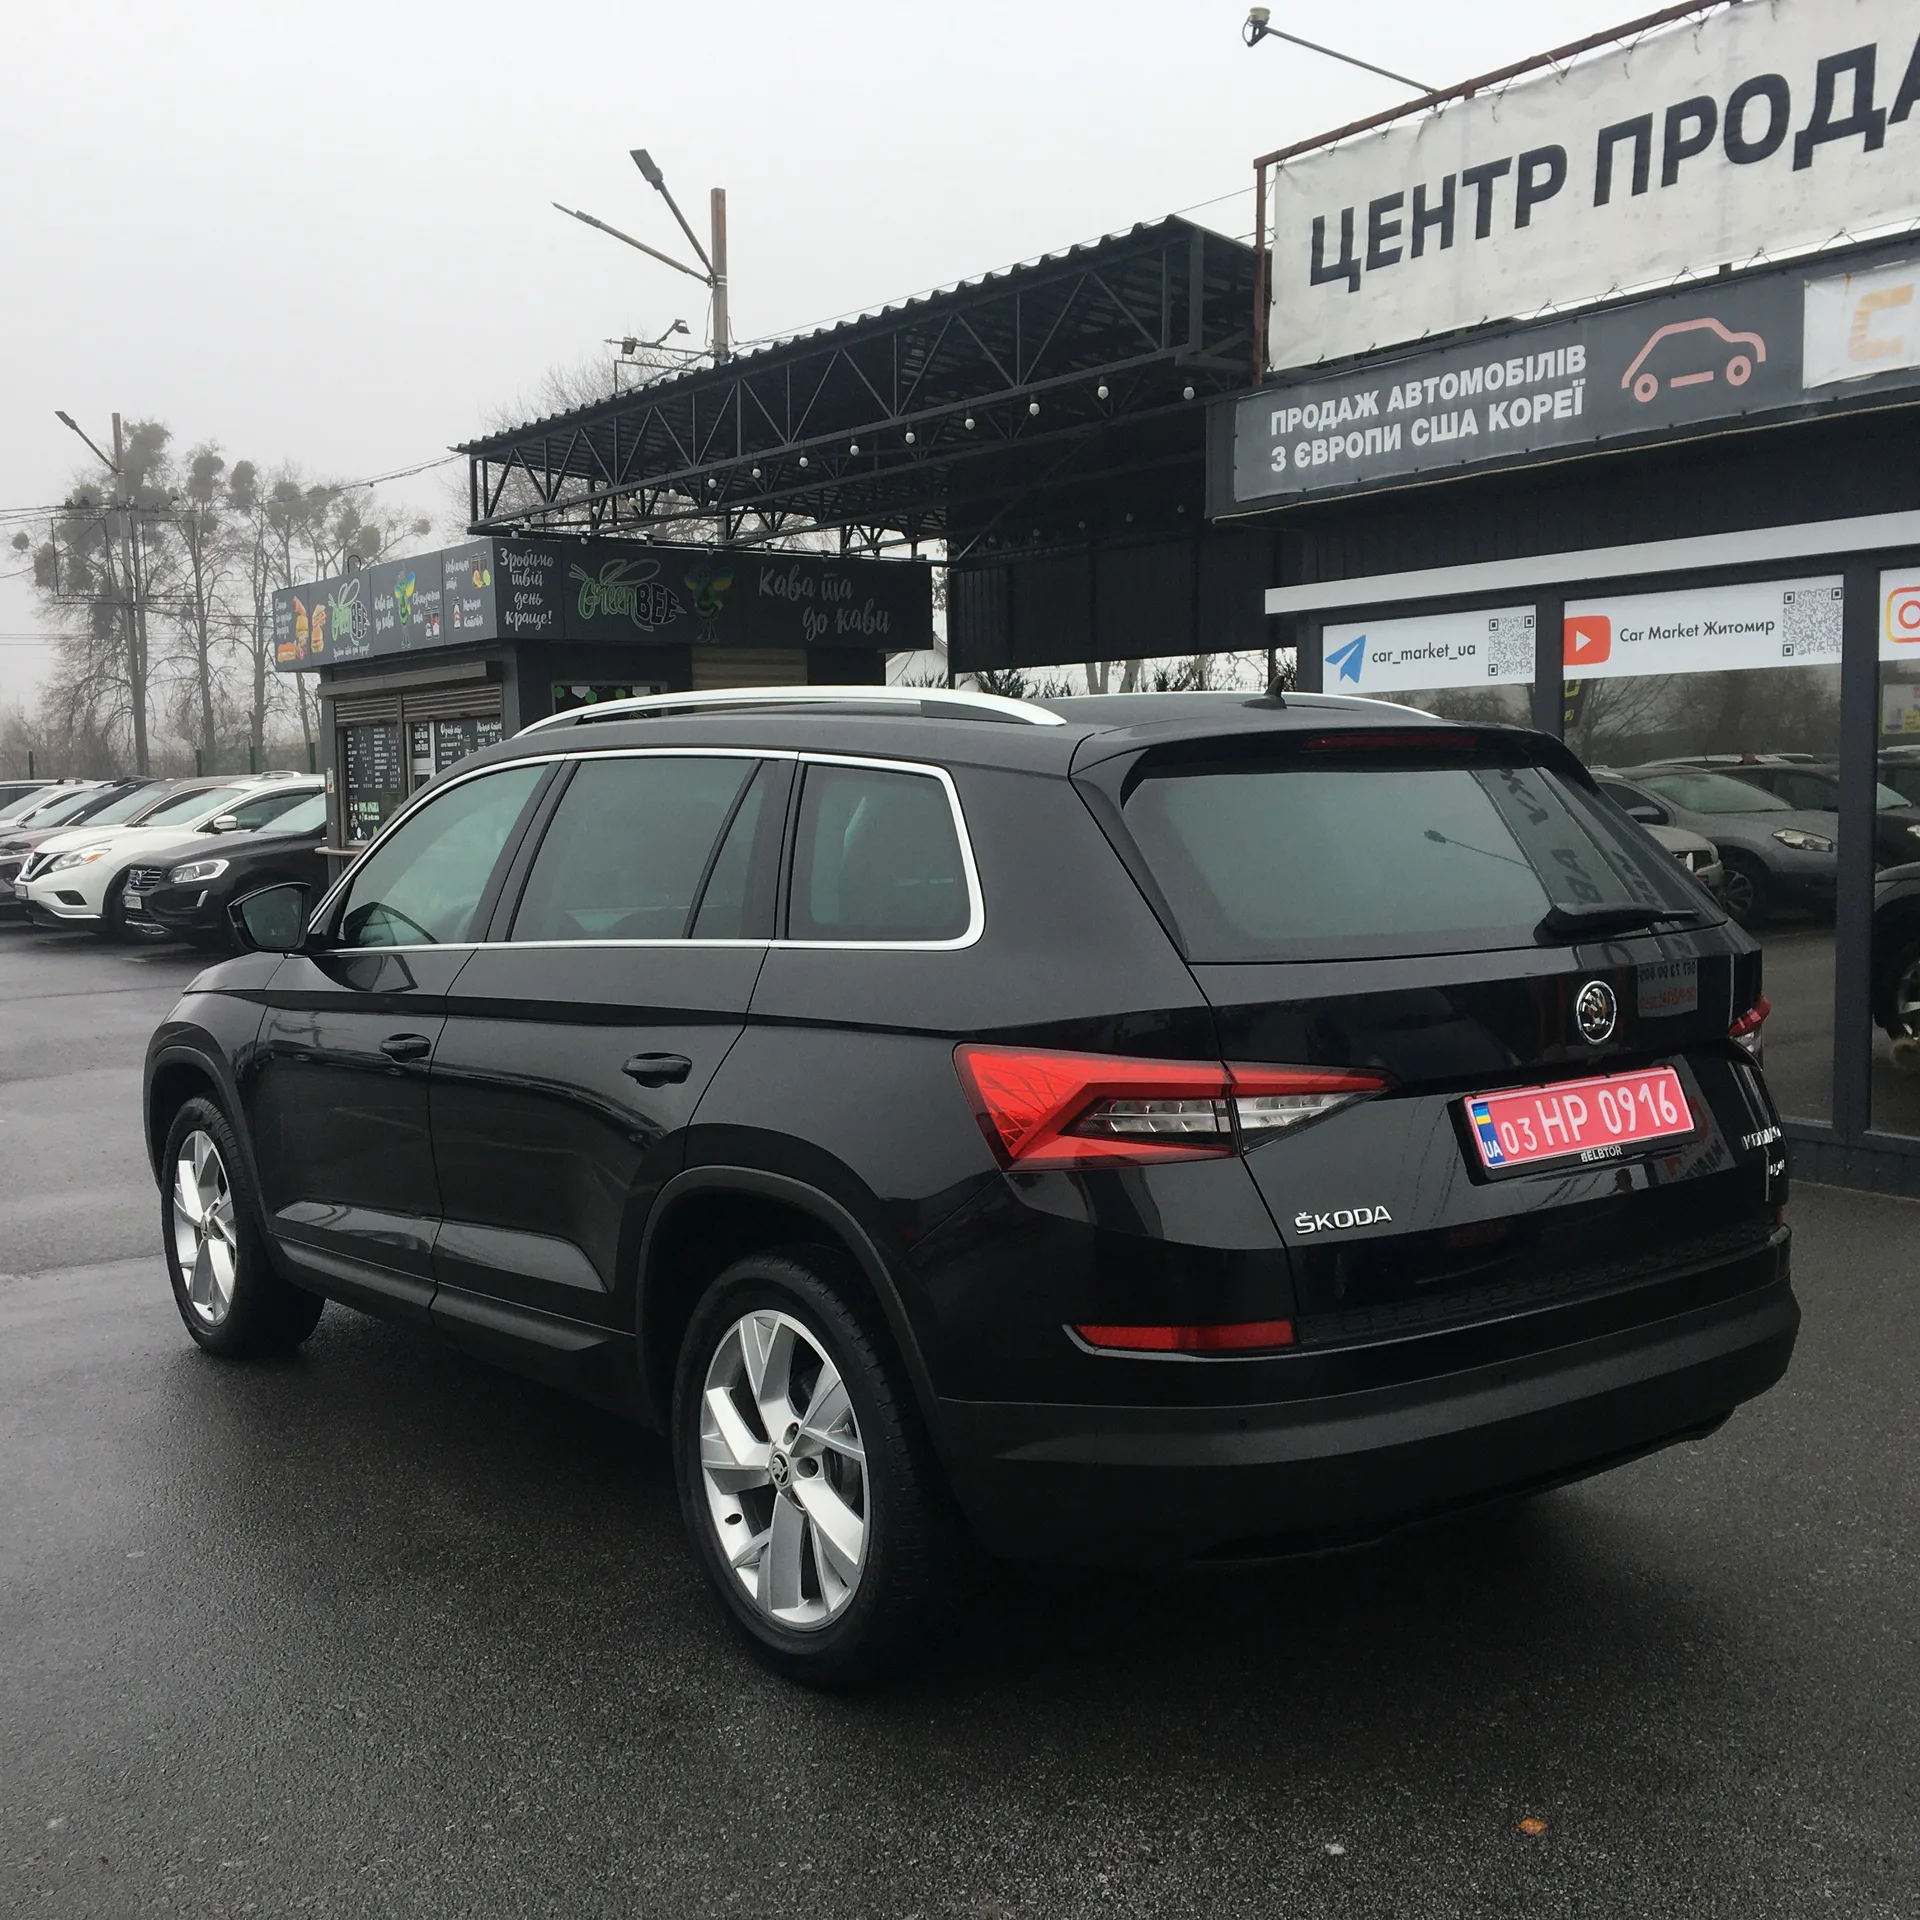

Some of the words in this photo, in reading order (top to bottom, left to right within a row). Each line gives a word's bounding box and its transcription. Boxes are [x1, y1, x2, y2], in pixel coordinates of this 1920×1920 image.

[1310, 144, 1568, 293] ЦЕНТР
[1271, 390, 1379, 436] ПРОДАЖ
[1386, 344, 1586, 413] АВТОМОБІЛІВ
[1271, 446, 1287, 472] З
[1294, 423, 1402, 468] ЄВРОПИ
[1411, 408, 1479, 446] США
[1489, 378, 1586, 432] КОРЕЇ
[500, 547, 554, 572] Зробимо
[511, 567, 544, 587] твій
[759, 564, 816, 601] Кава
[821, 573, 853, 601] та
[514, 592, 543, 610] день
[505, 610, 552, 631] краще!
[802, 606, 828, 641] до
[835, 598, 892, 635] кави
[1620, 628, 1644, 642] Car
[1648, 623, 1700, 640] Market
[1703, 620, 1775, 636] Житомир
[1372, 642, 1476, 664] car_market_ua
[1500, 1117, 1538, 1154] 03
[1599, 1080, 1678, 1135] 0916
[1483, 1140, 1503, 1158] UA
[1295, 1205, 1392, 1234] ŠKODA
